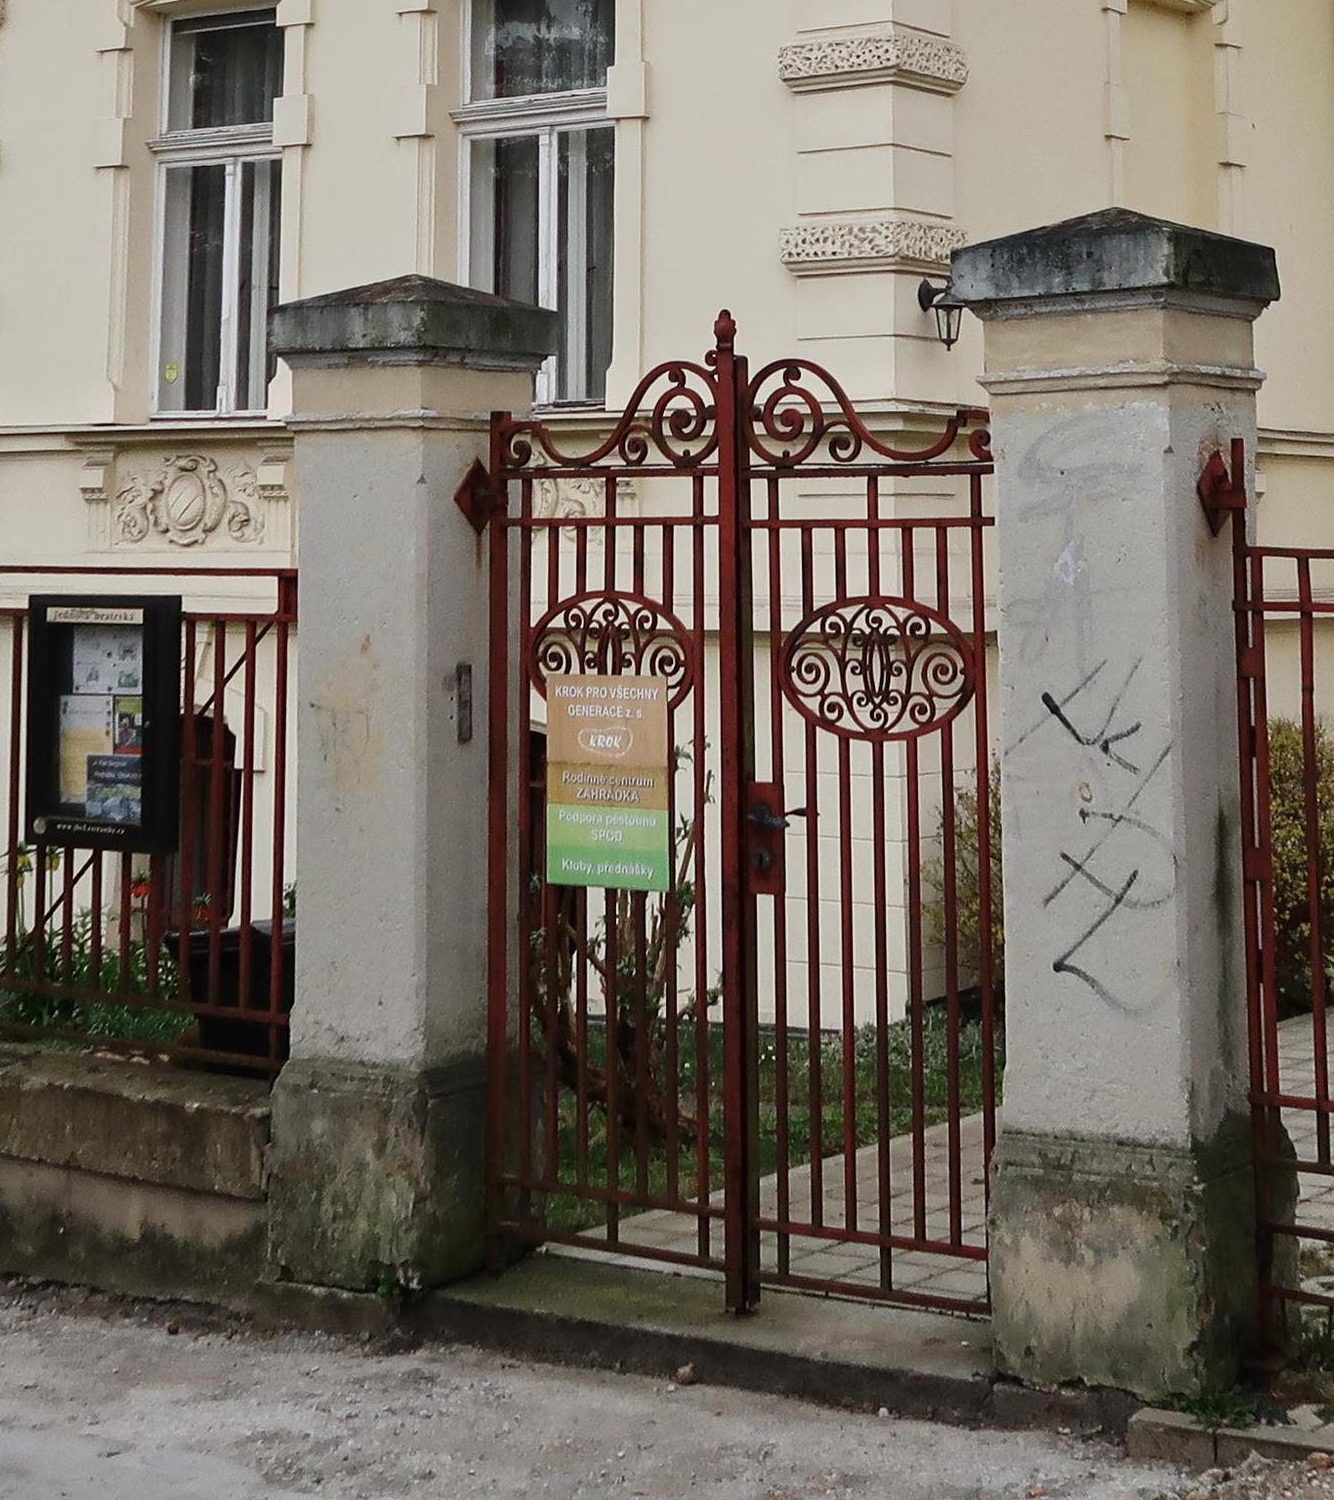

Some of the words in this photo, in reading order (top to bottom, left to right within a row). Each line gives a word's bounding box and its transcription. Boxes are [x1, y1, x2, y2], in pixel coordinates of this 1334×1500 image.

[555, 685, 584, 698] KROK
[586, 686, 607, 698] PRO
[609, 684, 658, 700] VŠECHNY
[568, 704, 623, 717] GENERACE
[589, 734, 622, 748] KROK
[609, 775, 654, 788] centrum
[559, 809, 603, 824] Podpora
[591, 829, 624, 843] SPOD
[562, 859, 595, 875] Kluby,
[597, 861, 654, 880] přednášky
